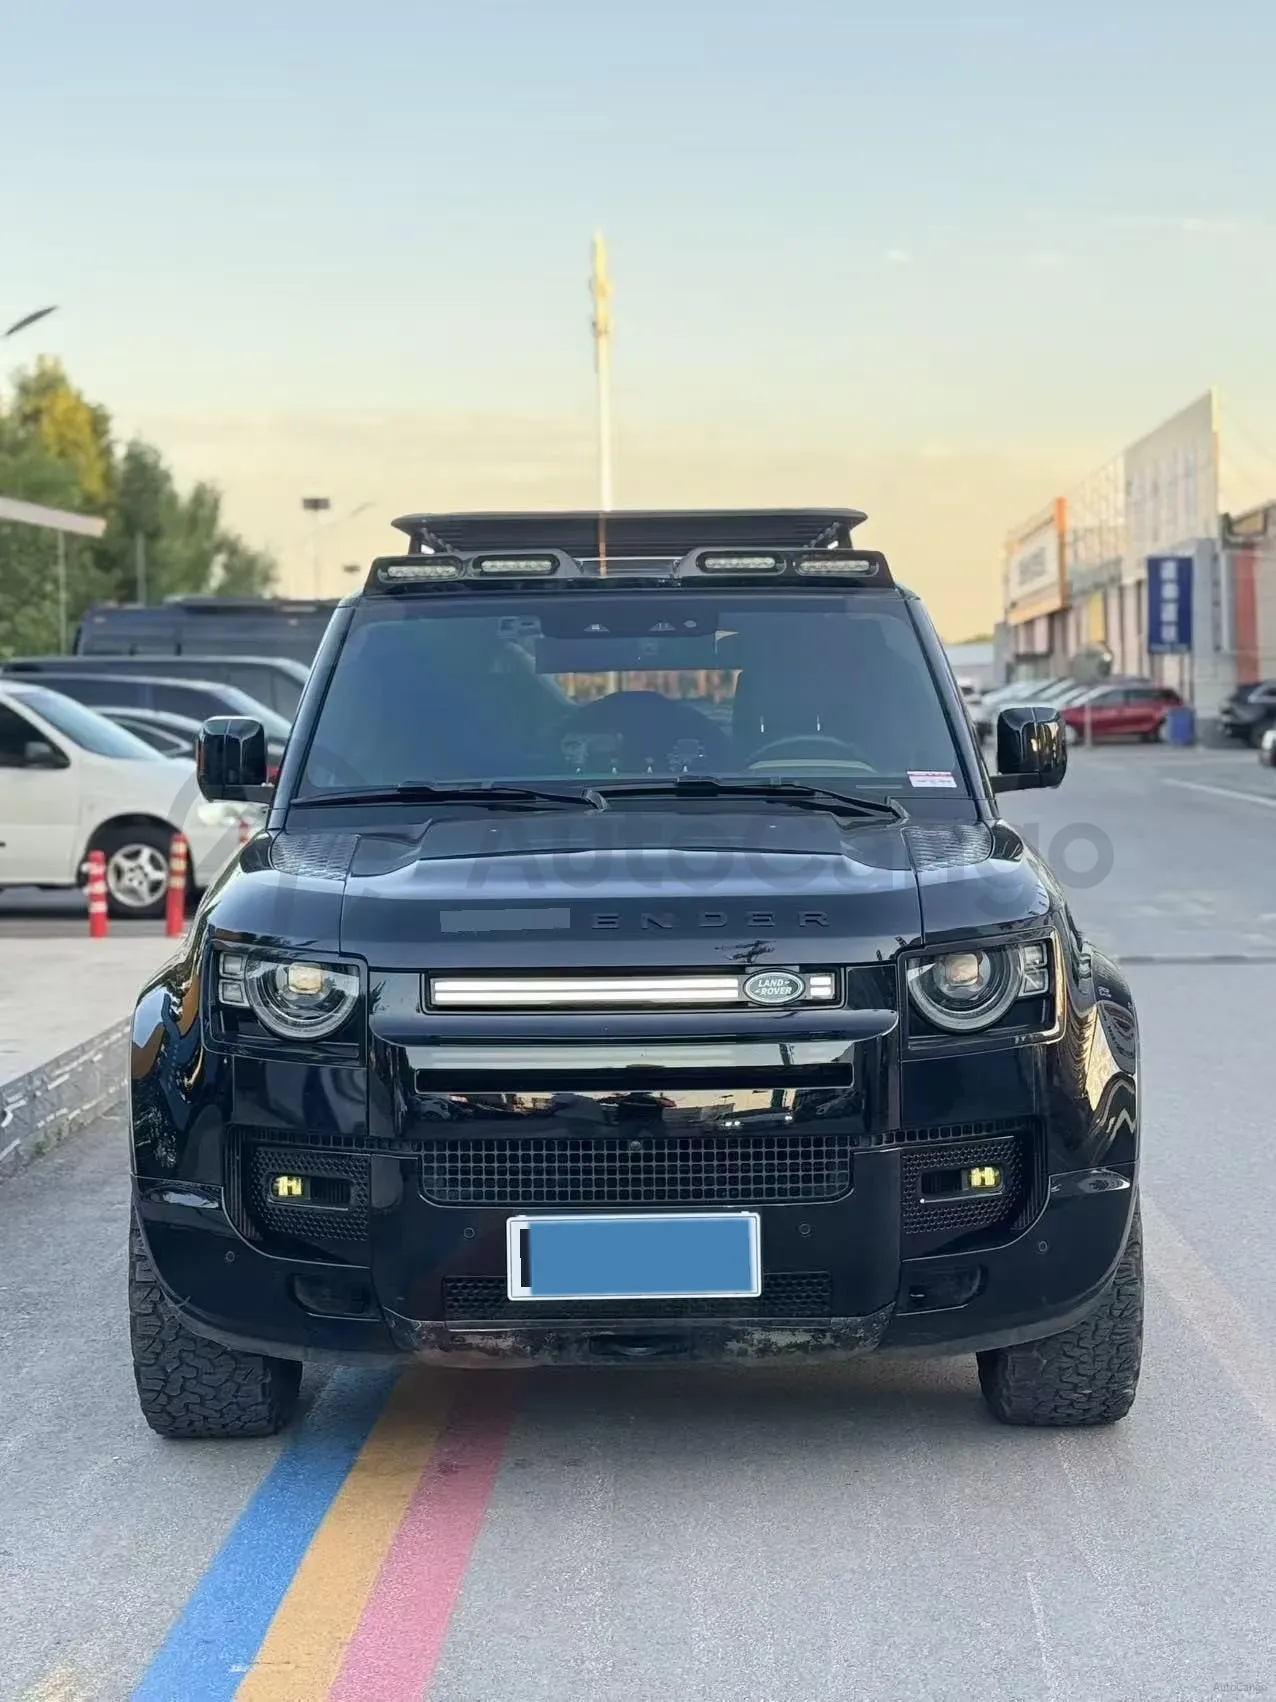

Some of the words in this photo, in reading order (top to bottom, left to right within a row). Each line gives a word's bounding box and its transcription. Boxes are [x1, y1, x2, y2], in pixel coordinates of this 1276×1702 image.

[440, 910, 830, 931] ENDER
[758, 979, 784, 987] LAND
[759, 986, 793, 996] ROVER
